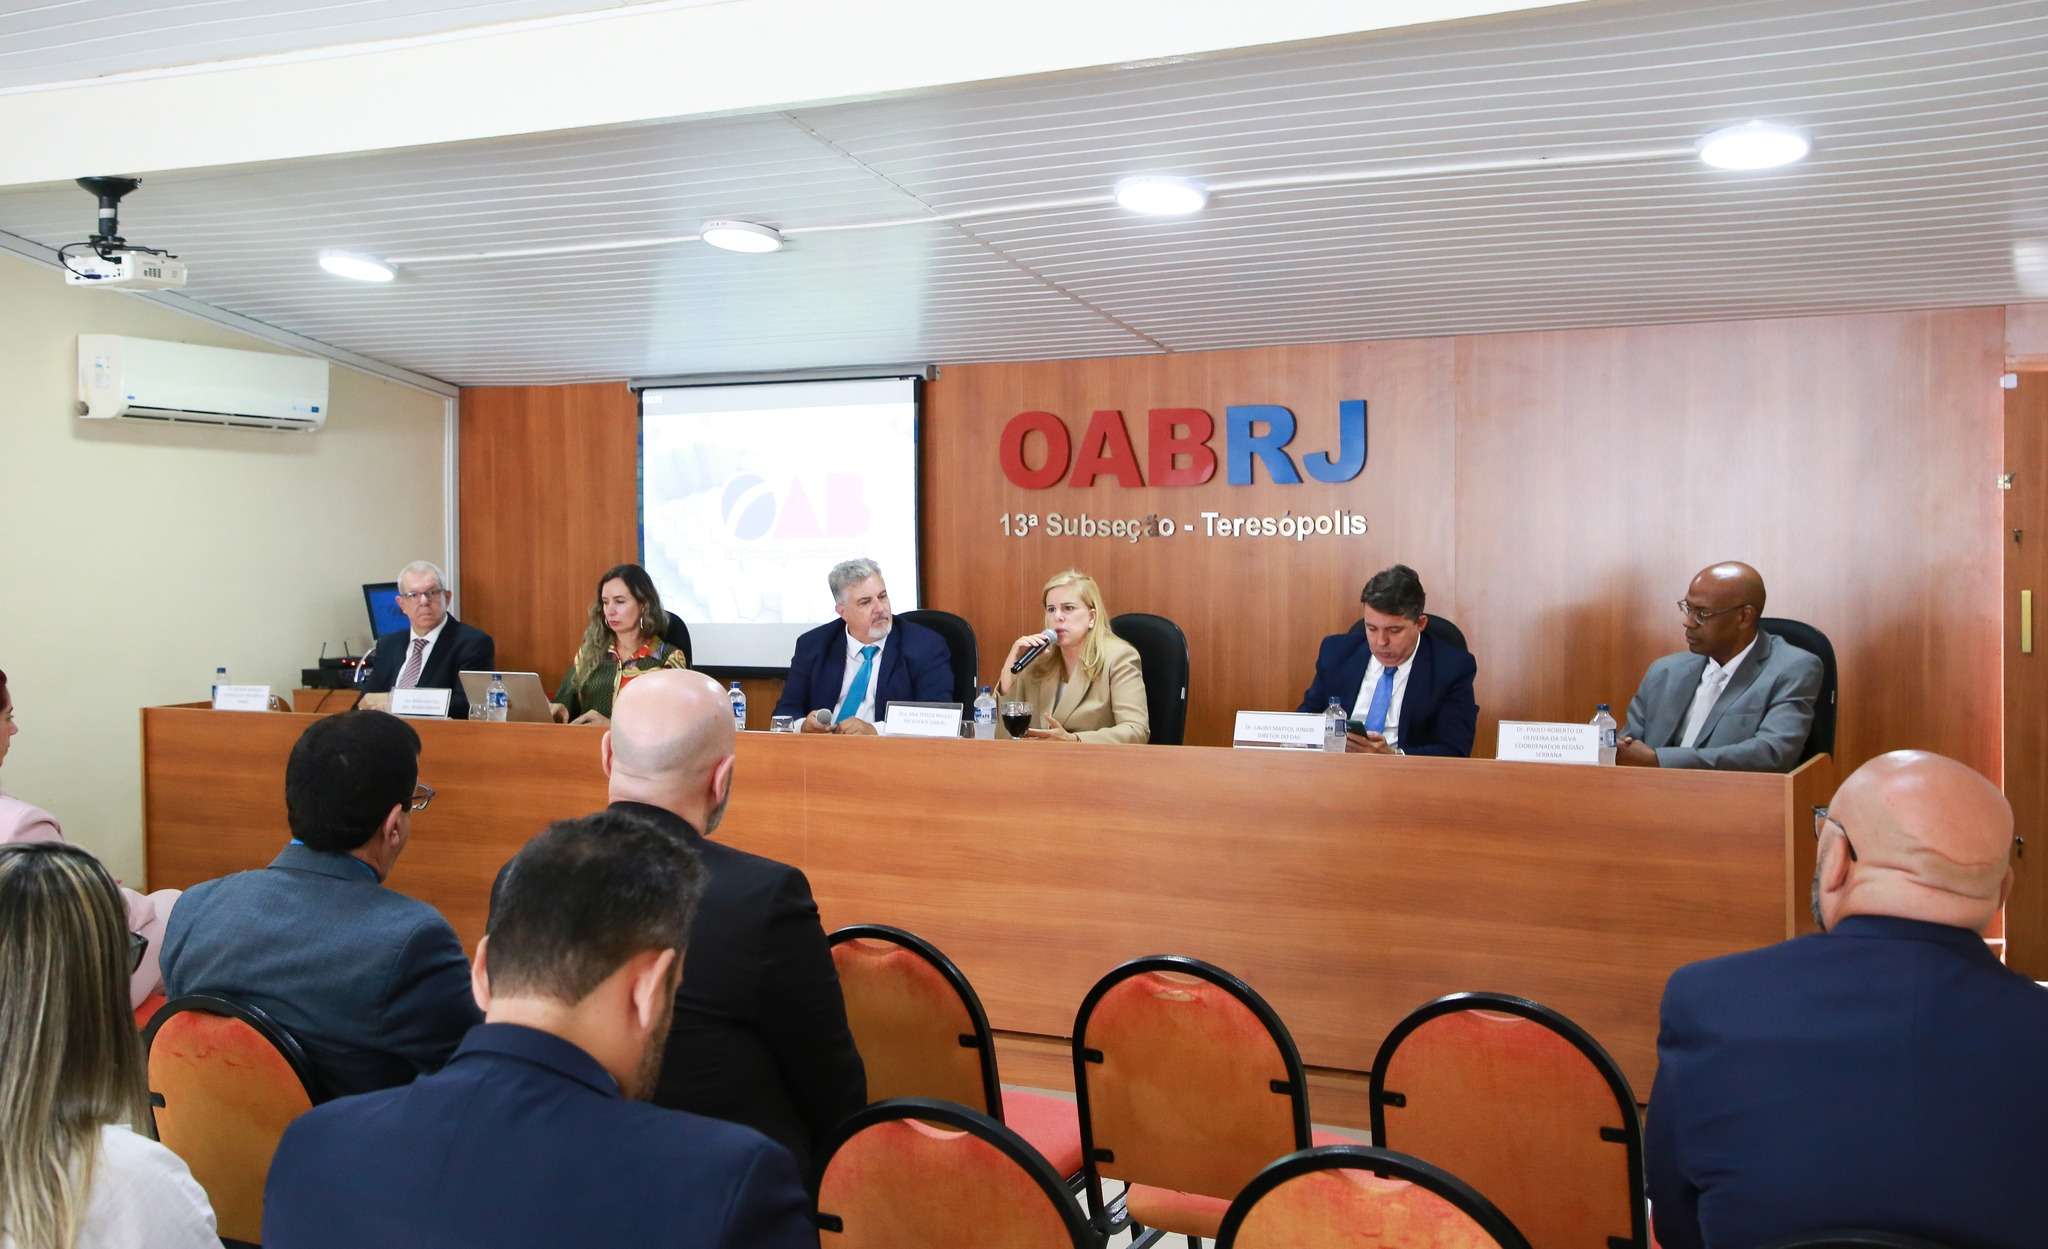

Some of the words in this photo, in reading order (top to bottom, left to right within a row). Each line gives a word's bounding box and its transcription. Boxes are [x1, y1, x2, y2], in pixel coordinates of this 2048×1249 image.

[721, 473, 871, 541] OAB
[1000, 512, 1039, 537] 13ª
[1046, 511, 1176, 544] Subseção
[1201, 509, 1368, 541] Teresópolis
